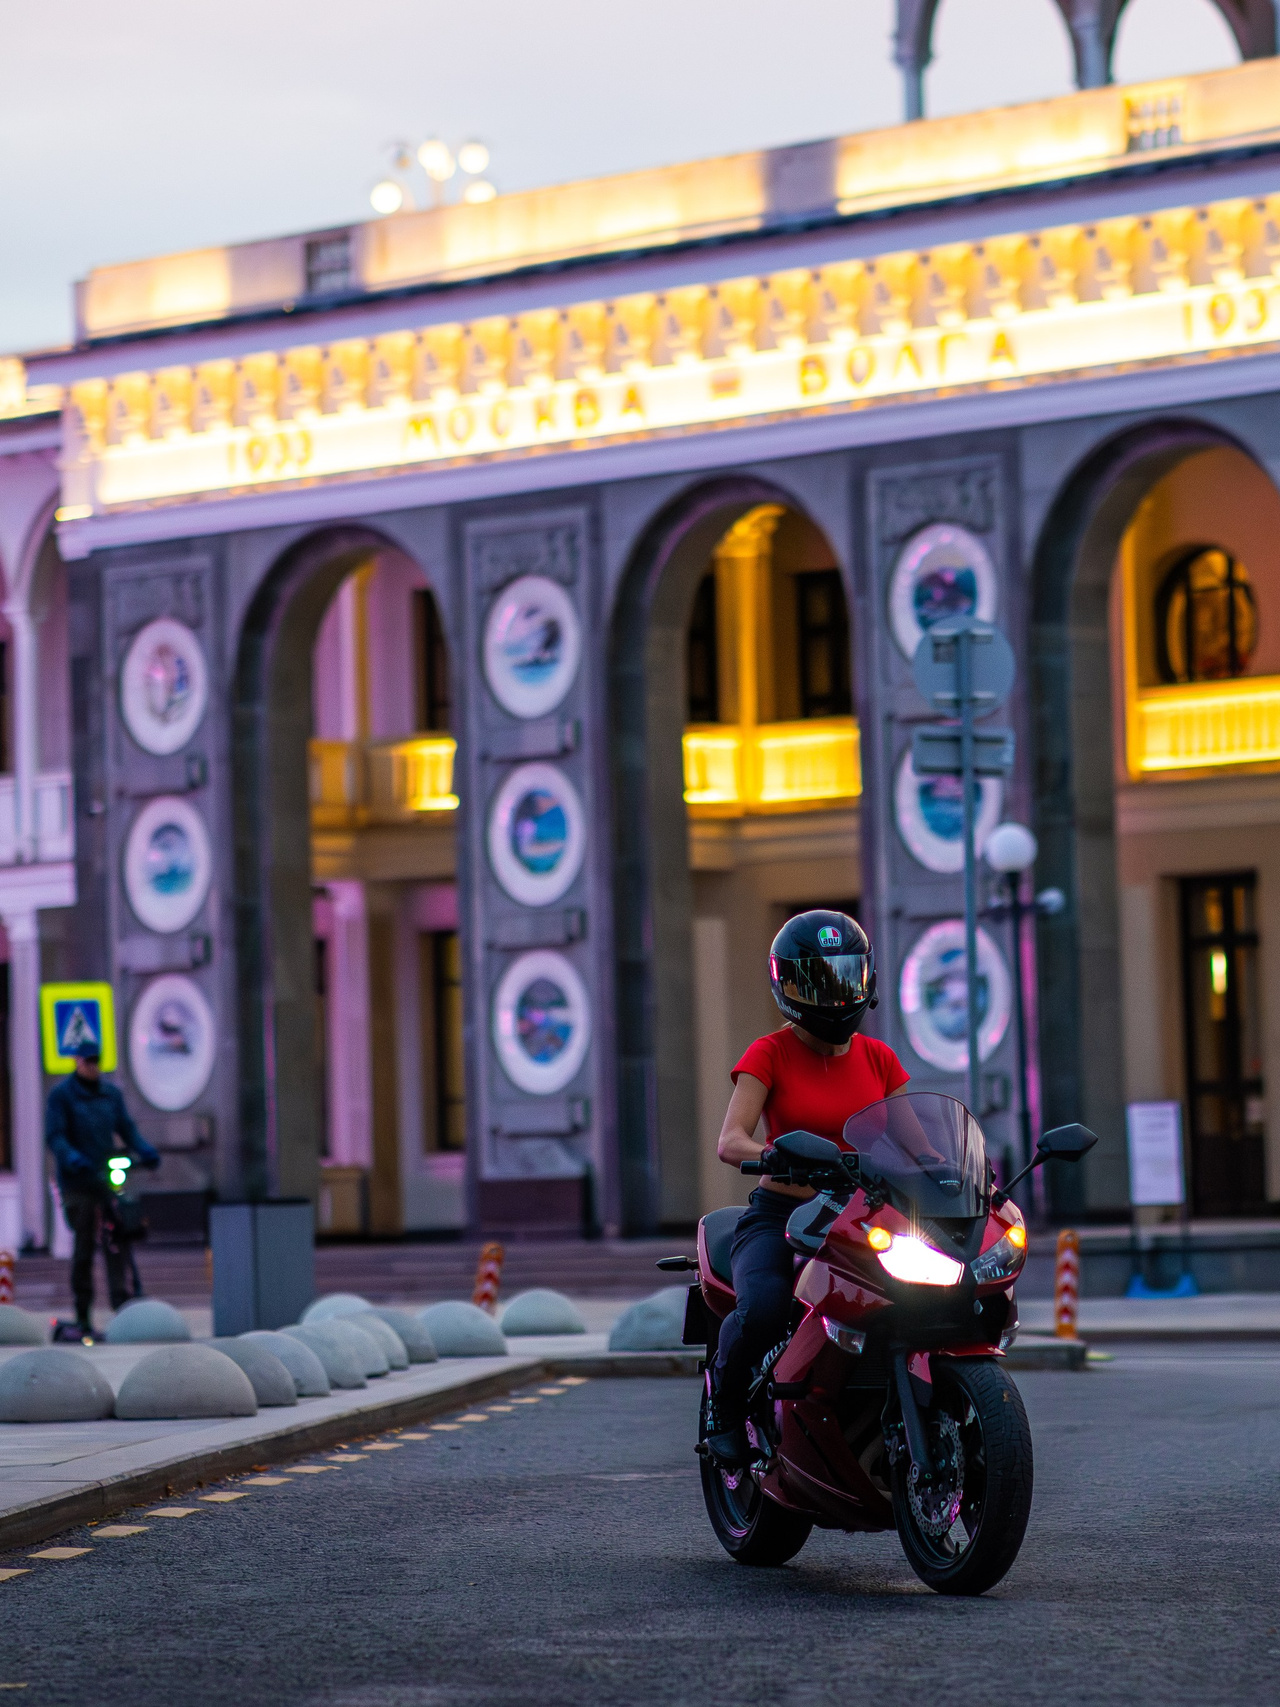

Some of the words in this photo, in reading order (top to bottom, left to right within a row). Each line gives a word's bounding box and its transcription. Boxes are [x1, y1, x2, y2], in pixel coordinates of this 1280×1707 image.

[404, 383, 648, 453] МОСКВА
[800, 331, 1018, 396] ВОЛГА
[819, 1195, 846, 1215] Kawasa
